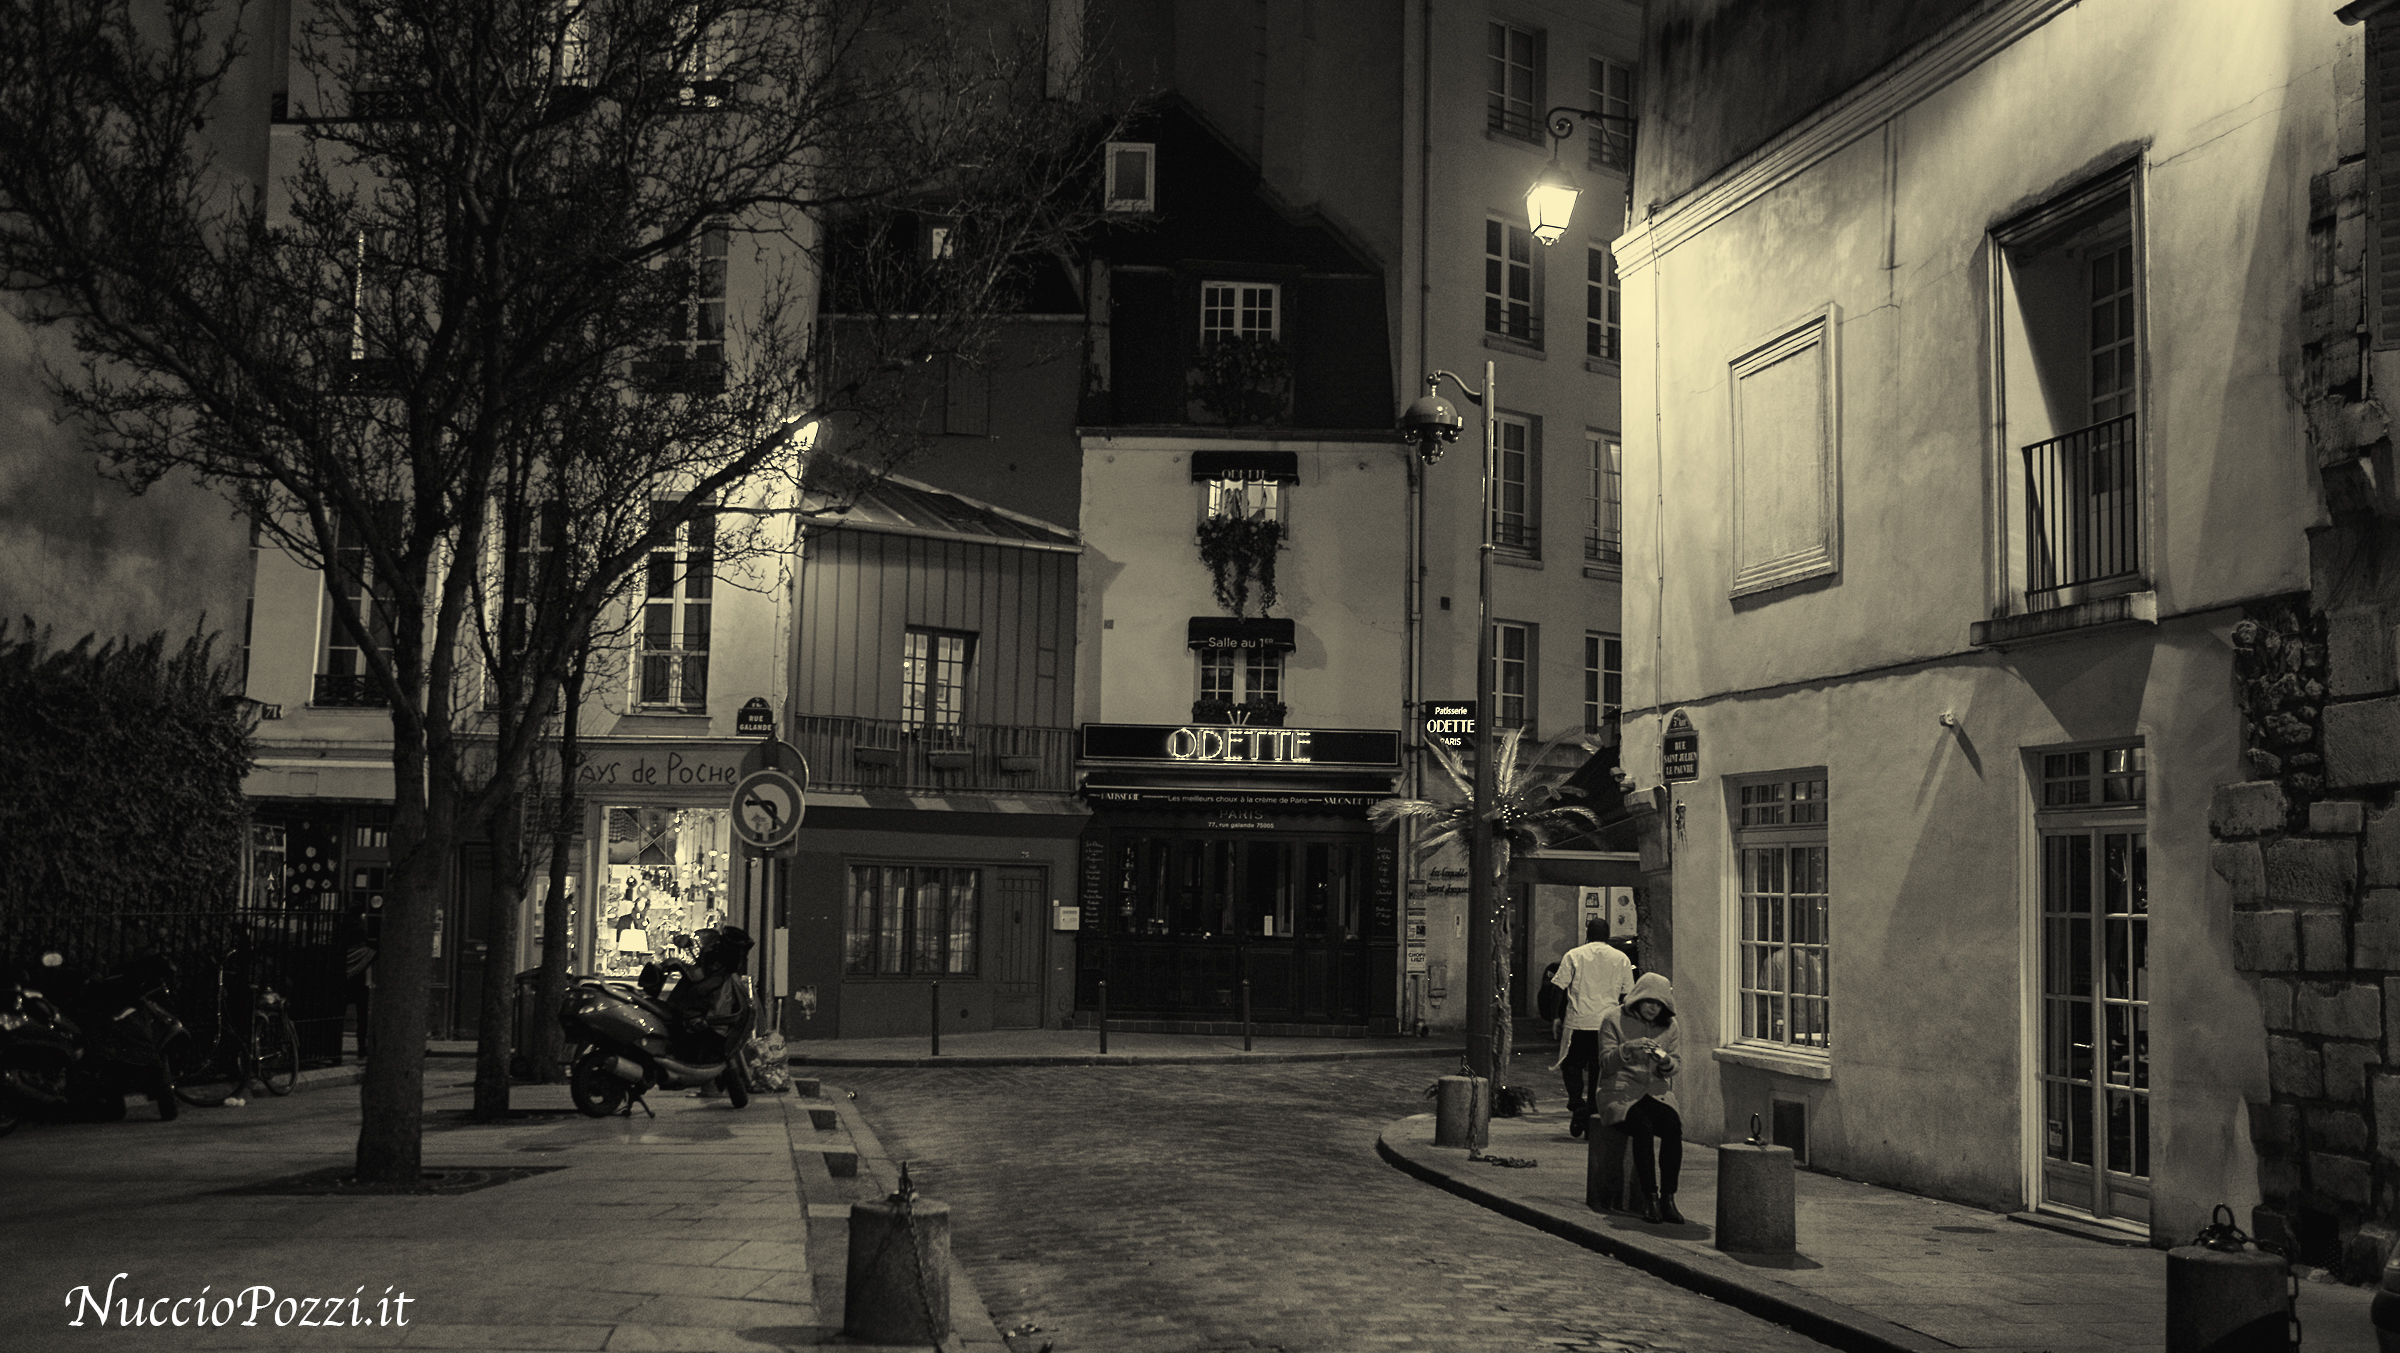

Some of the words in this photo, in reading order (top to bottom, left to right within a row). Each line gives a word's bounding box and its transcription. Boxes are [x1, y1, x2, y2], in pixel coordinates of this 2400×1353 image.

[1208, 636, 1237, 648] Salle
[1240, 639, 1256, 648] au
[739, 723, 772, 731] GALANDE
[1426, 719, 1475, 733] ODETTE
[1167, 726, 1311, 761] ODETTE
[1439, 737, 1461, 746] PARIS
[1674, 740, 1686, 751] RUE
[632, 758, 657, 785] de
[1665, 765, 1673, 775] LE
[1167, 794, 1181, 802] Les
[1182, 795, 1214, 803] meilleurs
[1219, 809, 1264, 820] PARIS
